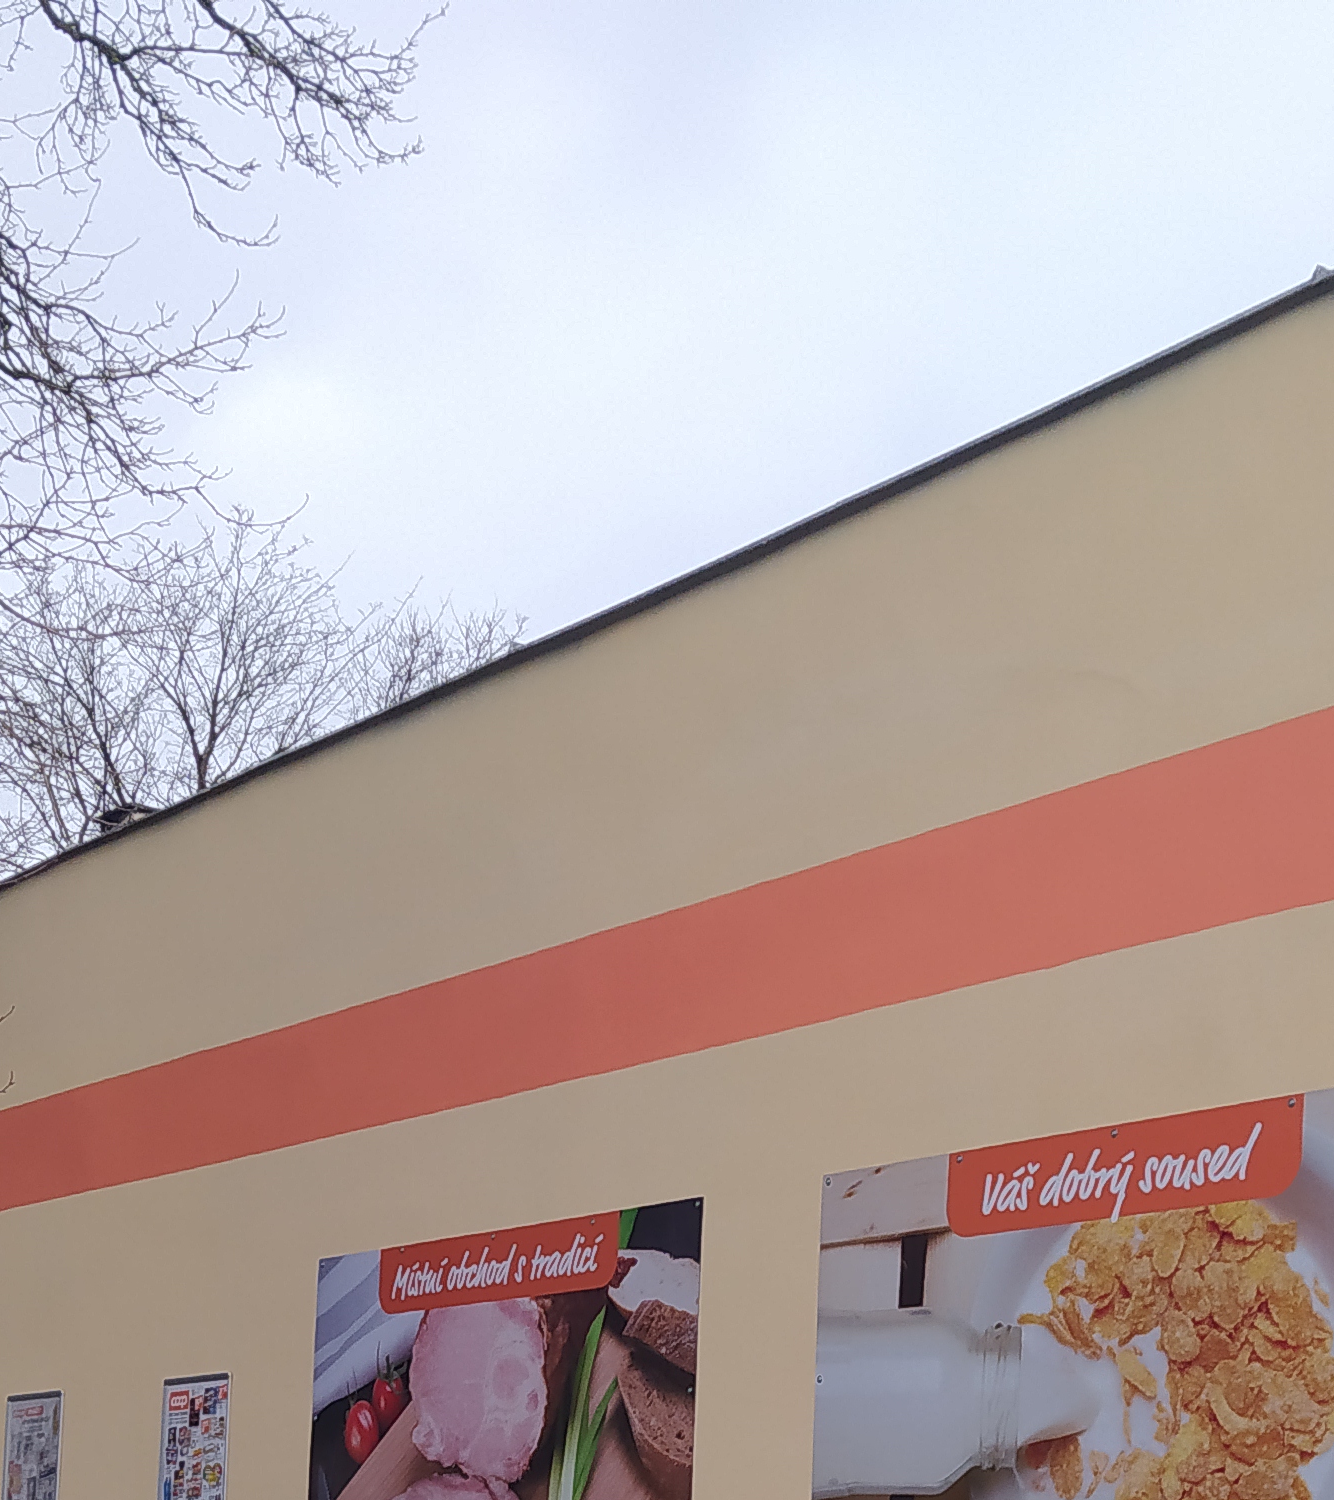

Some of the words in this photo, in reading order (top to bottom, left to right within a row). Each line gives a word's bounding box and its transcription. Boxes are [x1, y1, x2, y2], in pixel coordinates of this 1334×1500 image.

[982, 1162, 1041, 1216] Váš
[1039, 1148, 1135, 1223] dobrý
[1138, 1121, 1263, 1194] soused
[391, 1257, 449, 1301] Místní
[446, 1243, 517, 1291] obchod
[514, 1255, 527, 1284] s
[530, 1233, 604, 1281] tradicí
